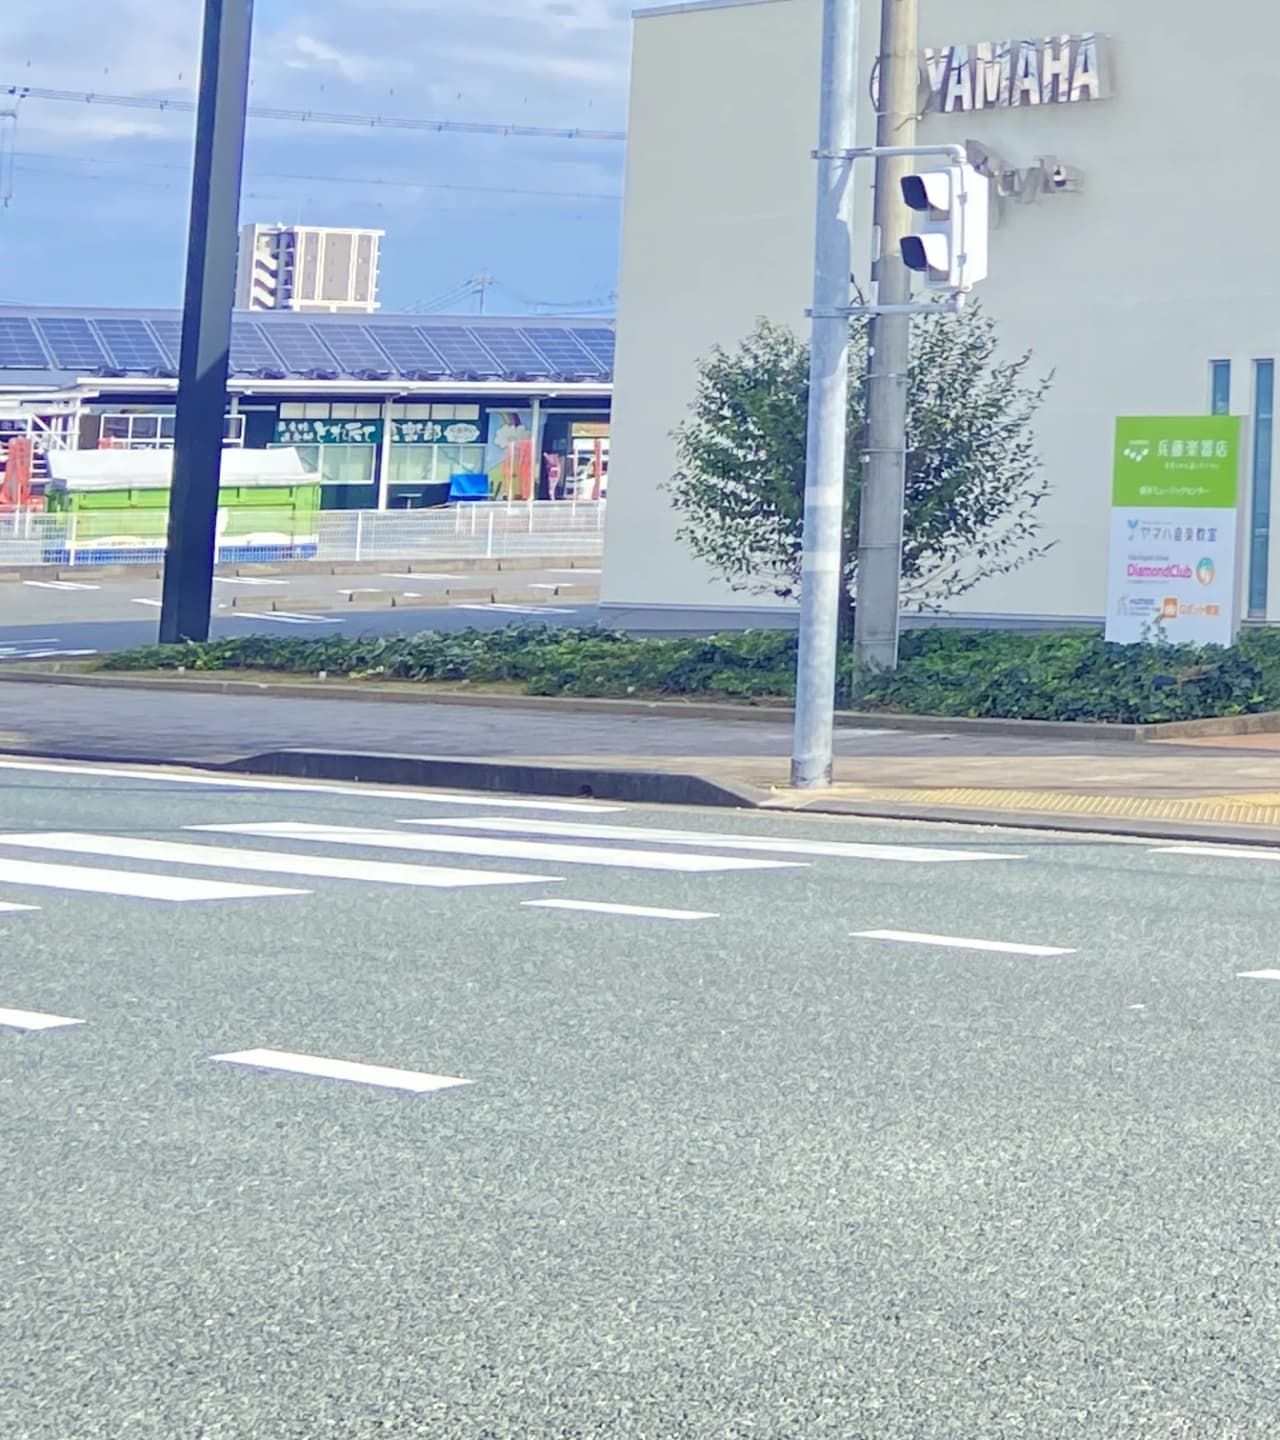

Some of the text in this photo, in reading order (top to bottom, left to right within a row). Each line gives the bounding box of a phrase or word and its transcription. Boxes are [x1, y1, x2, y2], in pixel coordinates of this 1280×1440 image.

[924, 32, 1100, 112] YAMAHA
[1157, 439, 1229, 458] 兵藤楽器店
[1141, 527, 1217, 542] ヤマハ音楽教室
[1127, 563, 1192, 579] DiamondClub
